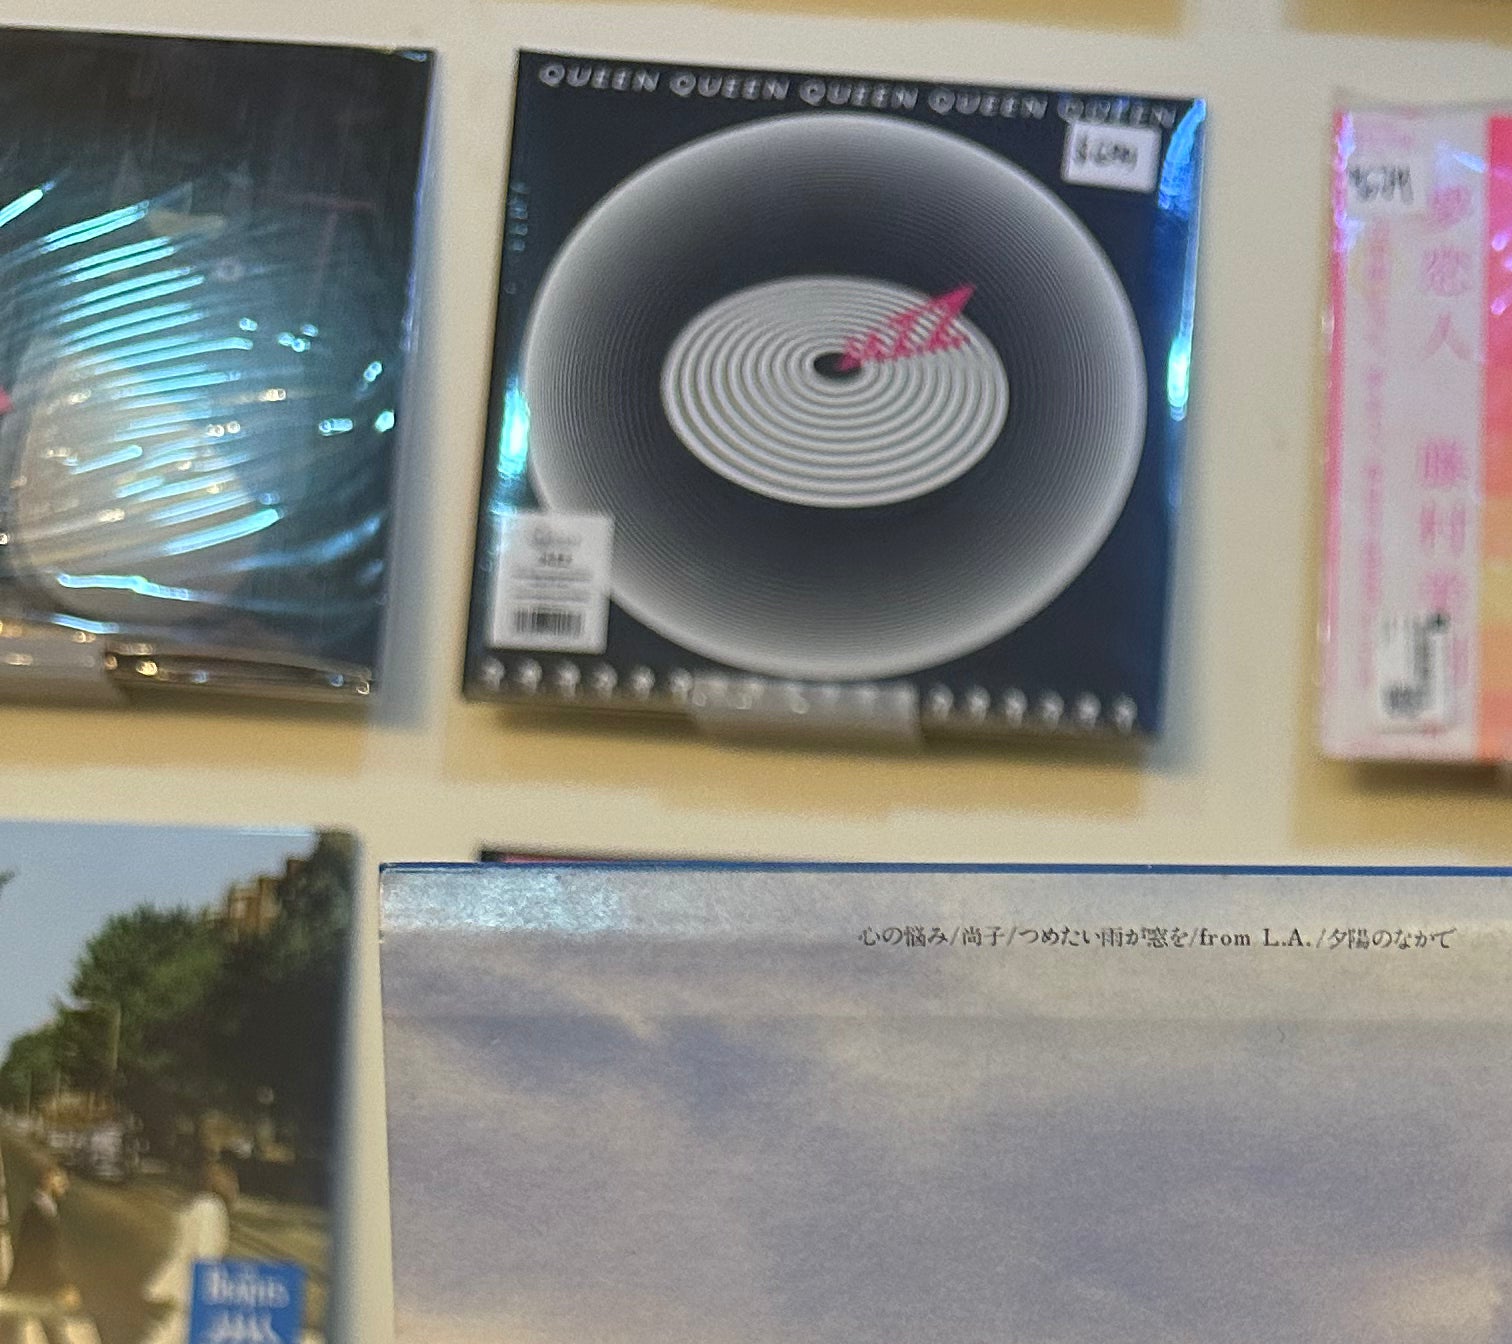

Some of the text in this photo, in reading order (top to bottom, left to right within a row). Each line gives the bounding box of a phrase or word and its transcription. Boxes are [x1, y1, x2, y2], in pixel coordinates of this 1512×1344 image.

[538, 61, 660, 93] QUEEN
[668, 69, 790, 101] QUEEN
[799, 77, 918, 110] QUEEN
[927, 86, 1048, 121] QUEEN
